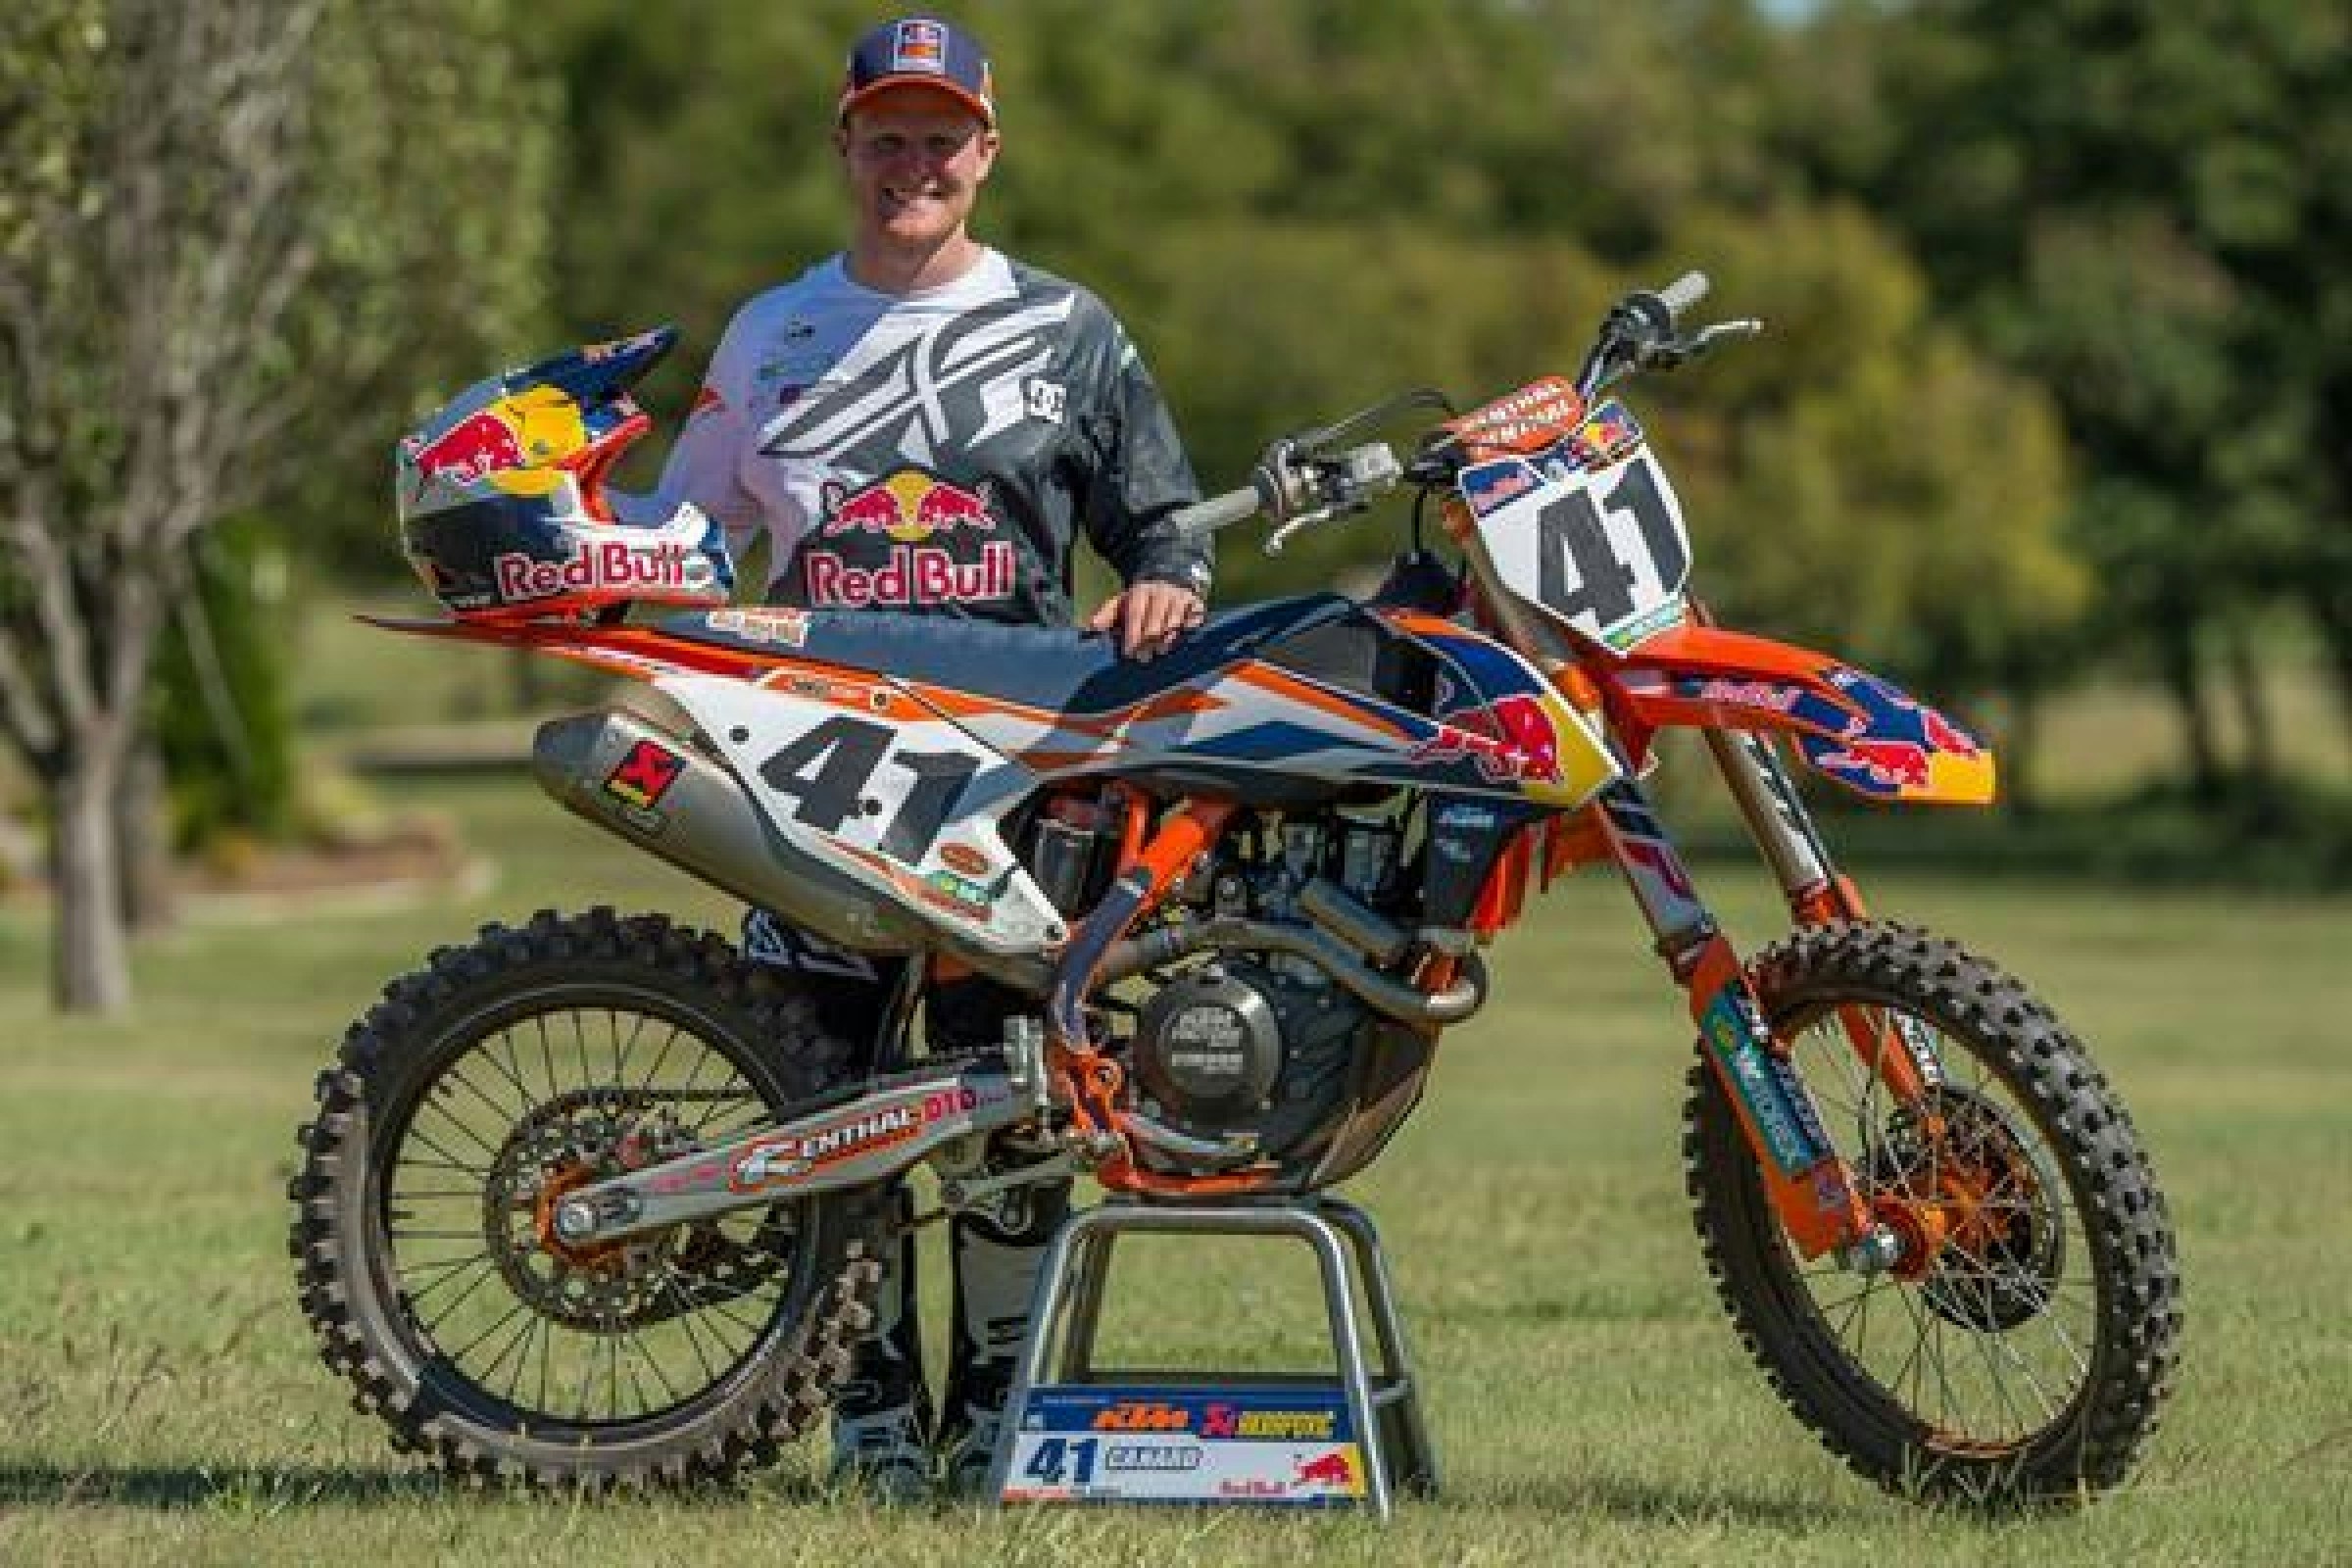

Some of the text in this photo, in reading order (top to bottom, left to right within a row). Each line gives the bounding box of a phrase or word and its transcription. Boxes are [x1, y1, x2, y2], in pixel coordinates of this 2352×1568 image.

[497, 543, 684, 600] Red Bull
[806, 540, 1015, 608] Red Bull
[1538, 458, 1686, 626] 41
[758, 716, 981, 866] 41
[1024, 1438, 1099, 1484] 41
